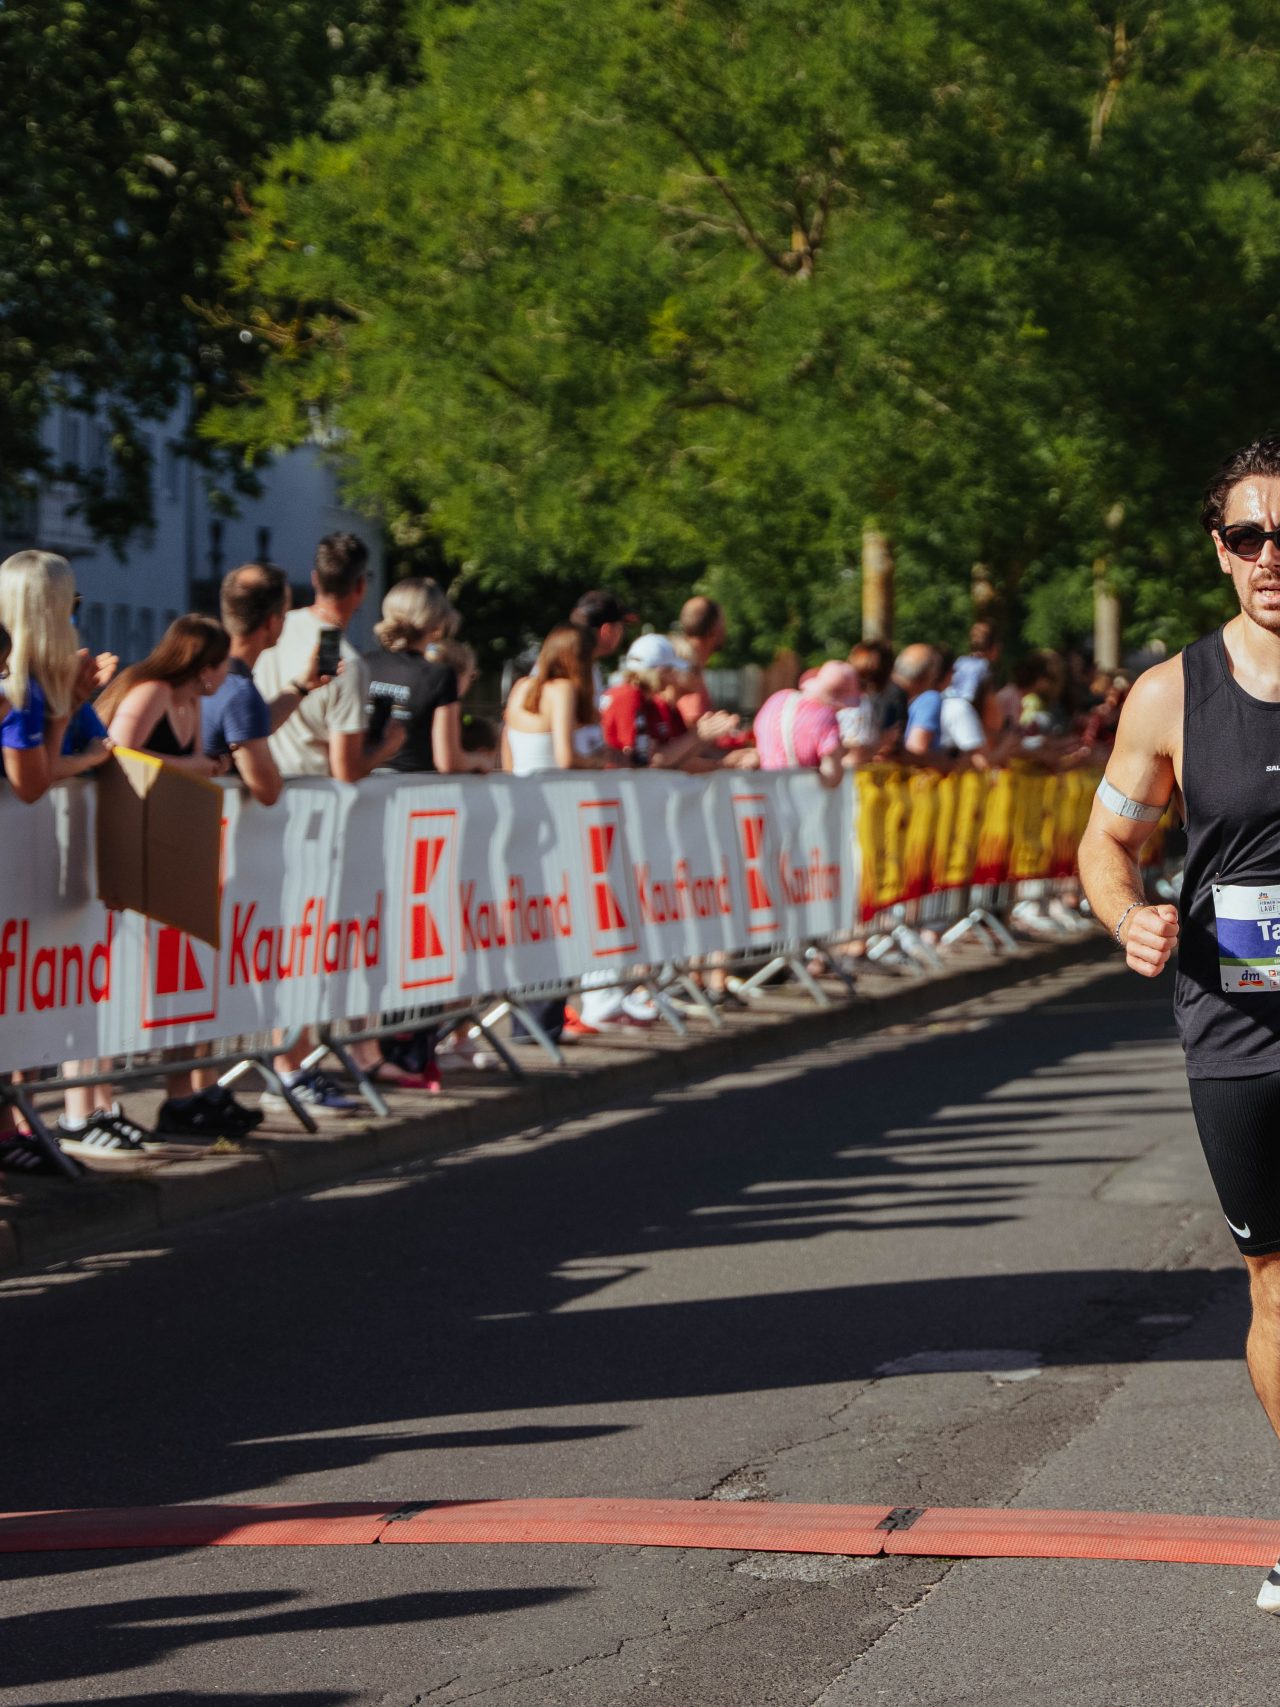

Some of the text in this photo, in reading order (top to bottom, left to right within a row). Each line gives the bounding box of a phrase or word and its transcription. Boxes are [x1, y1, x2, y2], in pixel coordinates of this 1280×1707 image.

[459, 870, 573, 953] Kaufland
[634, 854, 732, 926] Kaufland
[1260, 905, 1276, 913] LAUF
[228, 890, 383, 987] Kaufland
[1241, 970, 1260, 981] dm
